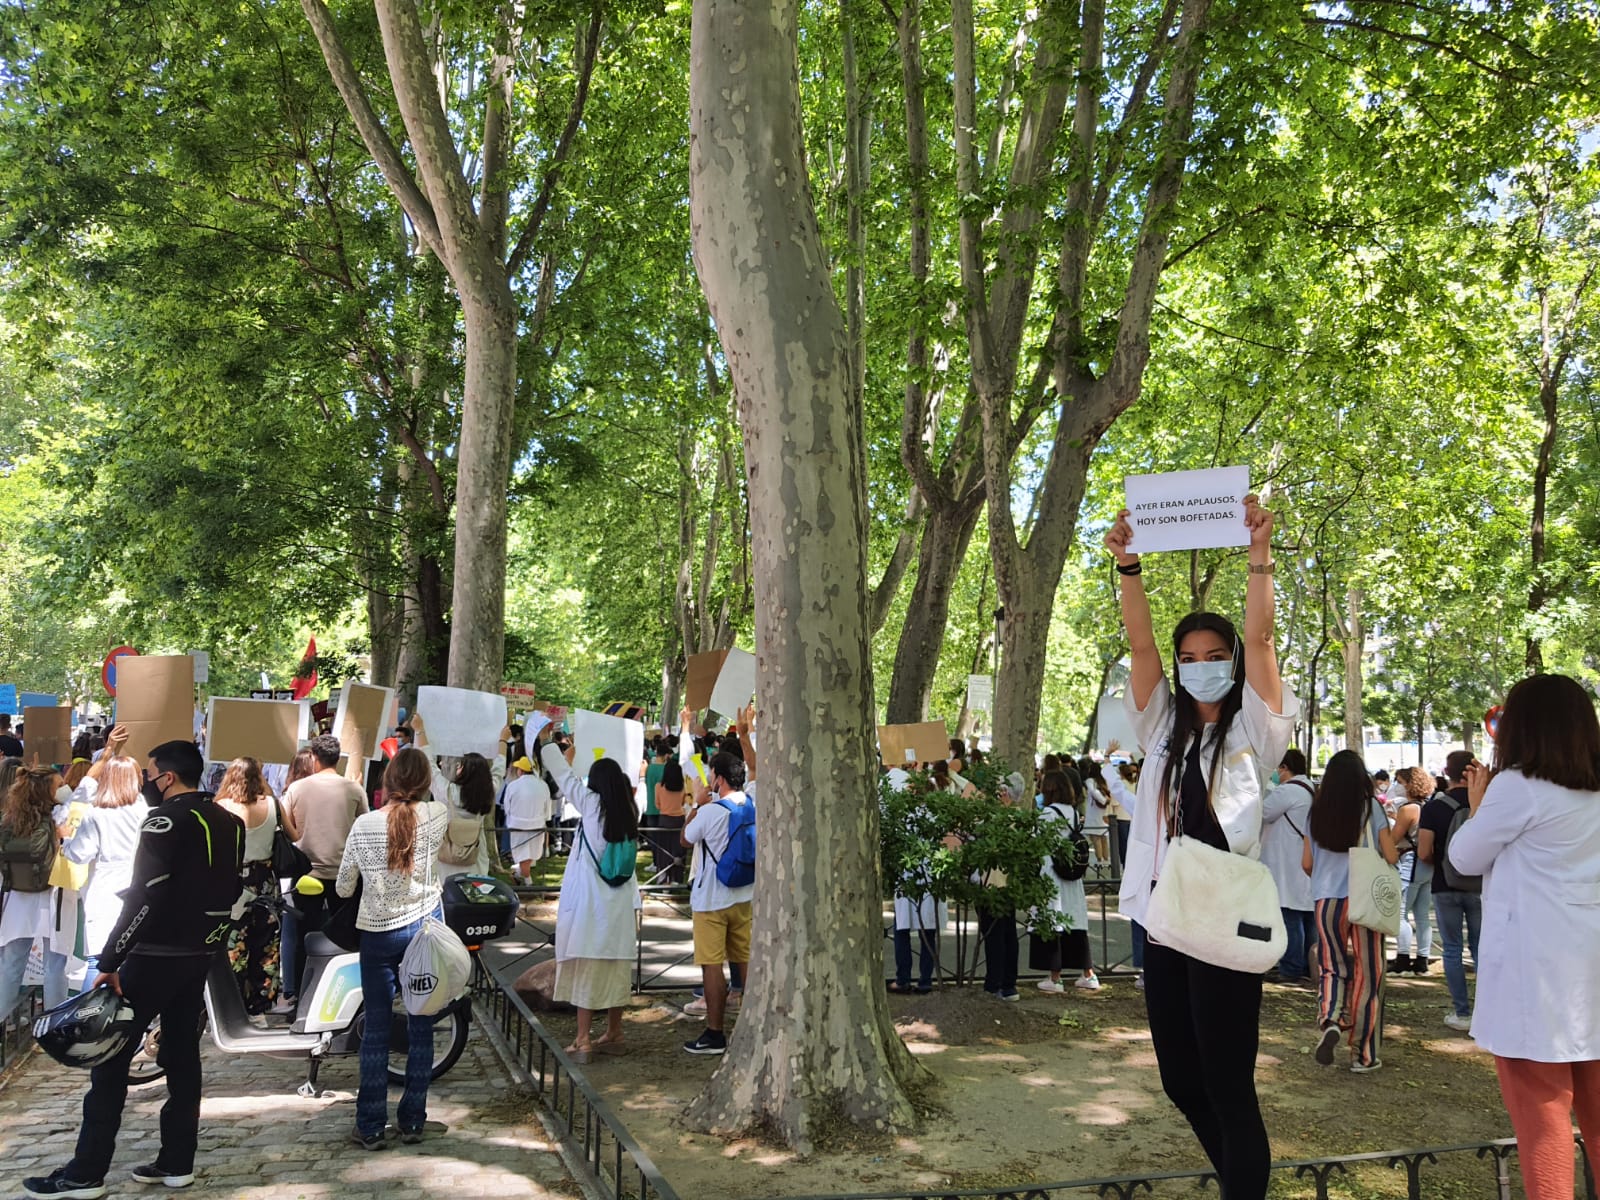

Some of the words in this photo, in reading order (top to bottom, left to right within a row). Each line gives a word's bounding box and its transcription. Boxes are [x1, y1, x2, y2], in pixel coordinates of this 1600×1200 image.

[1135, 502, 1158, 511] AYER
[1160, 500, 1185, 510] ERAN
[1187, 495, 1238, 507] APLAUSOS,
[1137, 516, 1156, 526] HOY
[1158, 515, 1178, 525] SON
[1180, 511, 1237, 523] BOFETADAS.
[466, 925, 497, 936] 0398
